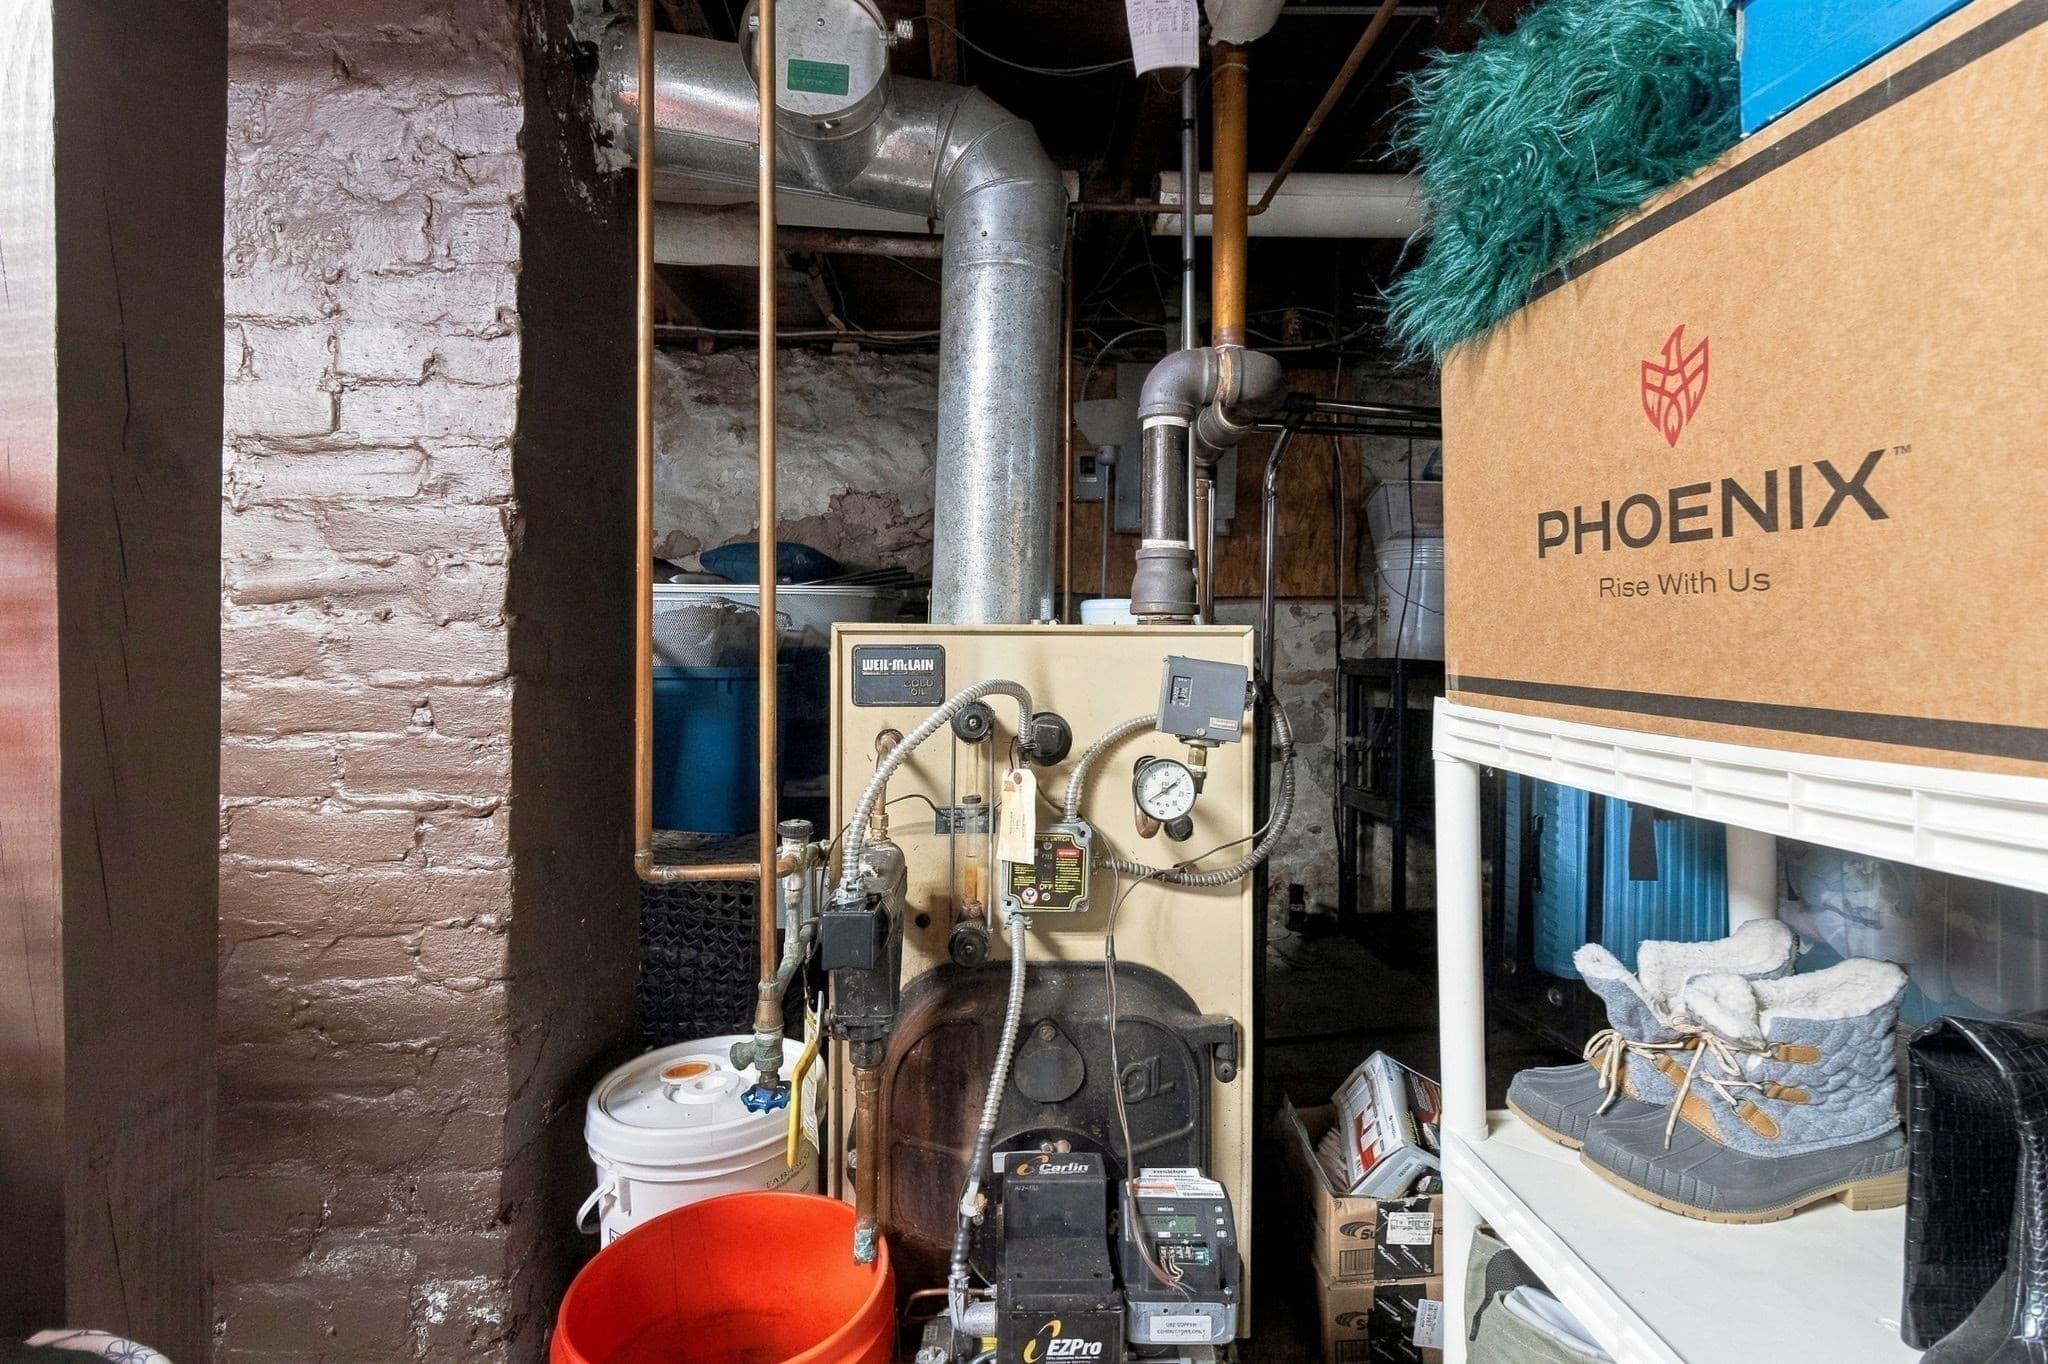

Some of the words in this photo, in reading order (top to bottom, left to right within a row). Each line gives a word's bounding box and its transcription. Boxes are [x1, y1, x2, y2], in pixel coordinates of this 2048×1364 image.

[1537, 449, 1889, 558] PHOENIX
[1599, 577, 1649, 598] Rise
[1657, 571, 1716, 595] With
[1727, 568, 1770, 593] Us
[1039, 1162, 1089, 1172] Carlin
[1046, 1338, 1102, 1356] EZPro
